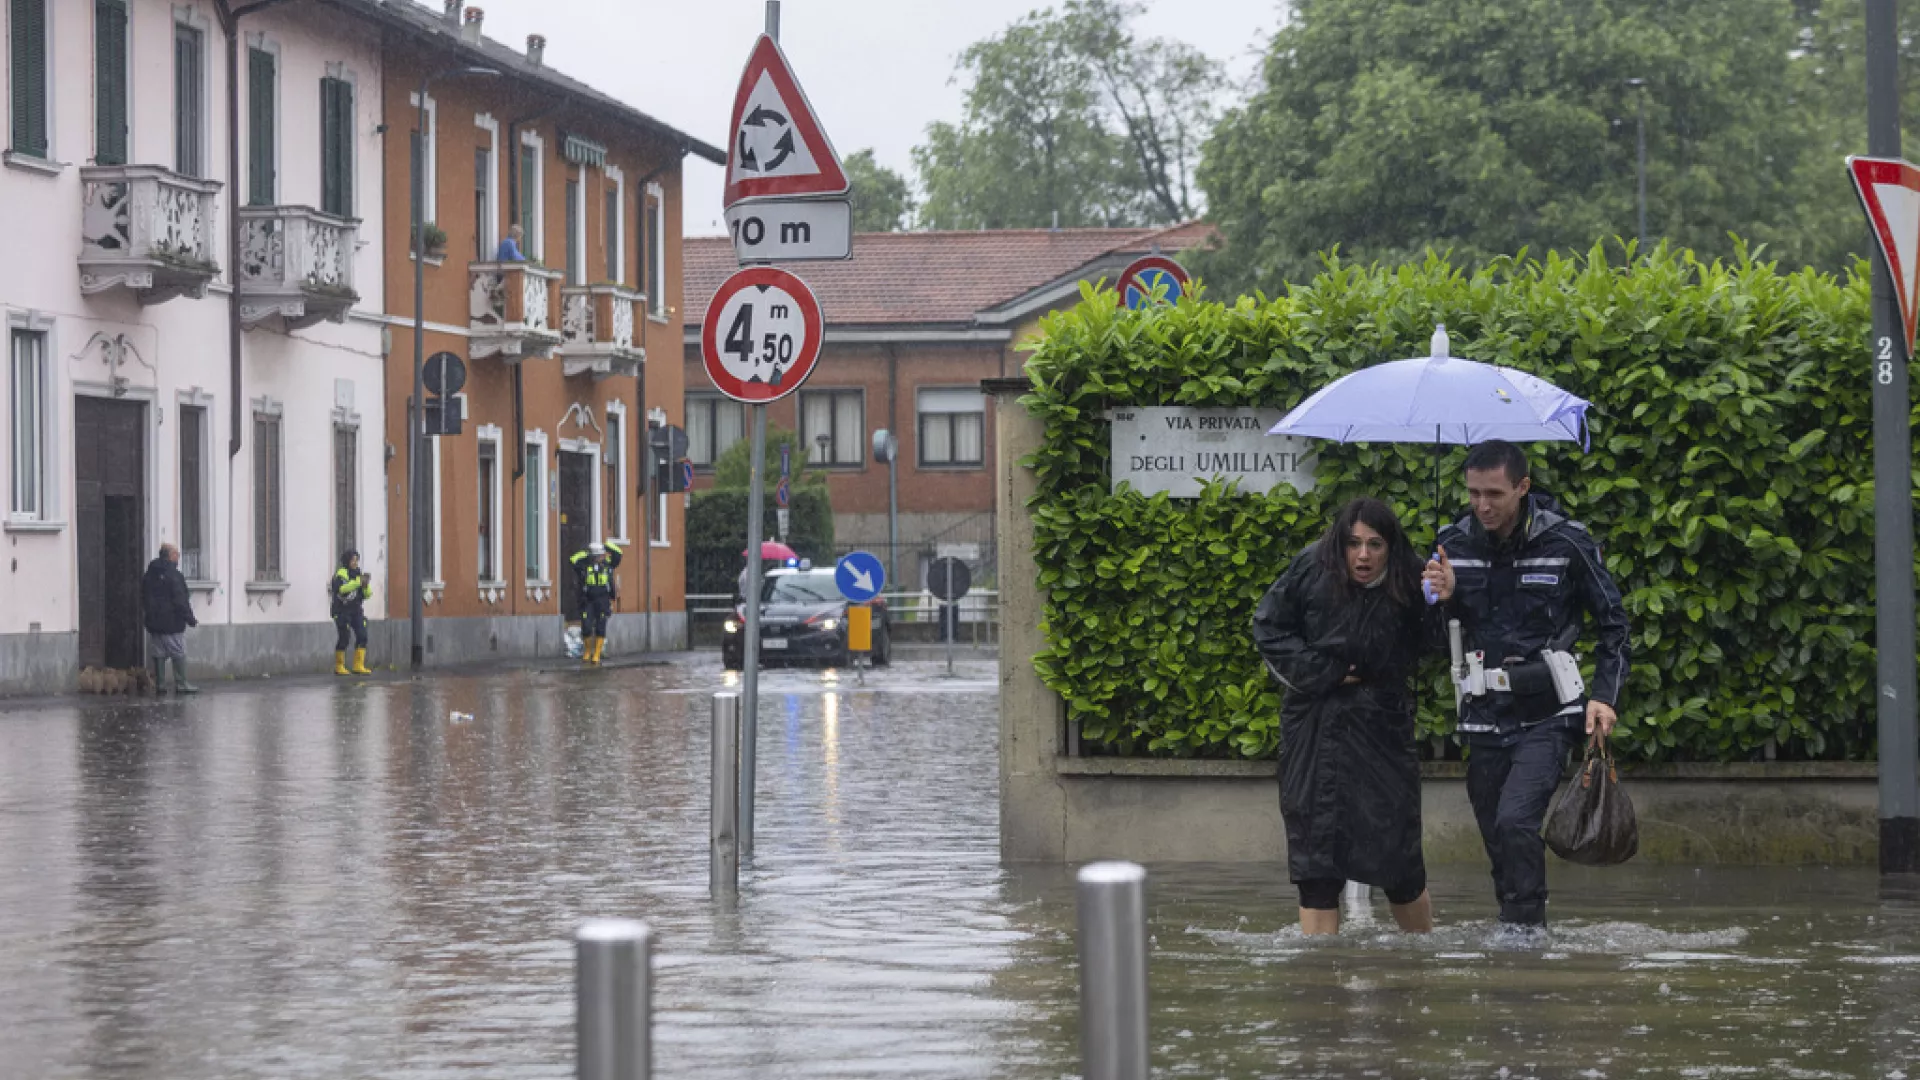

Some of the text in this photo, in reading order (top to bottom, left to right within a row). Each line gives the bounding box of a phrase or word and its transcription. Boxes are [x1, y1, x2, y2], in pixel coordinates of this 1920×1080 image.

[780, 221, 811, 244] m
[770, 304, 788, 319] m
[1165, 416, 1261, 430] VIA PRIVATA
[1131, 452, 1297, 473] DEGLI UMILIATI
